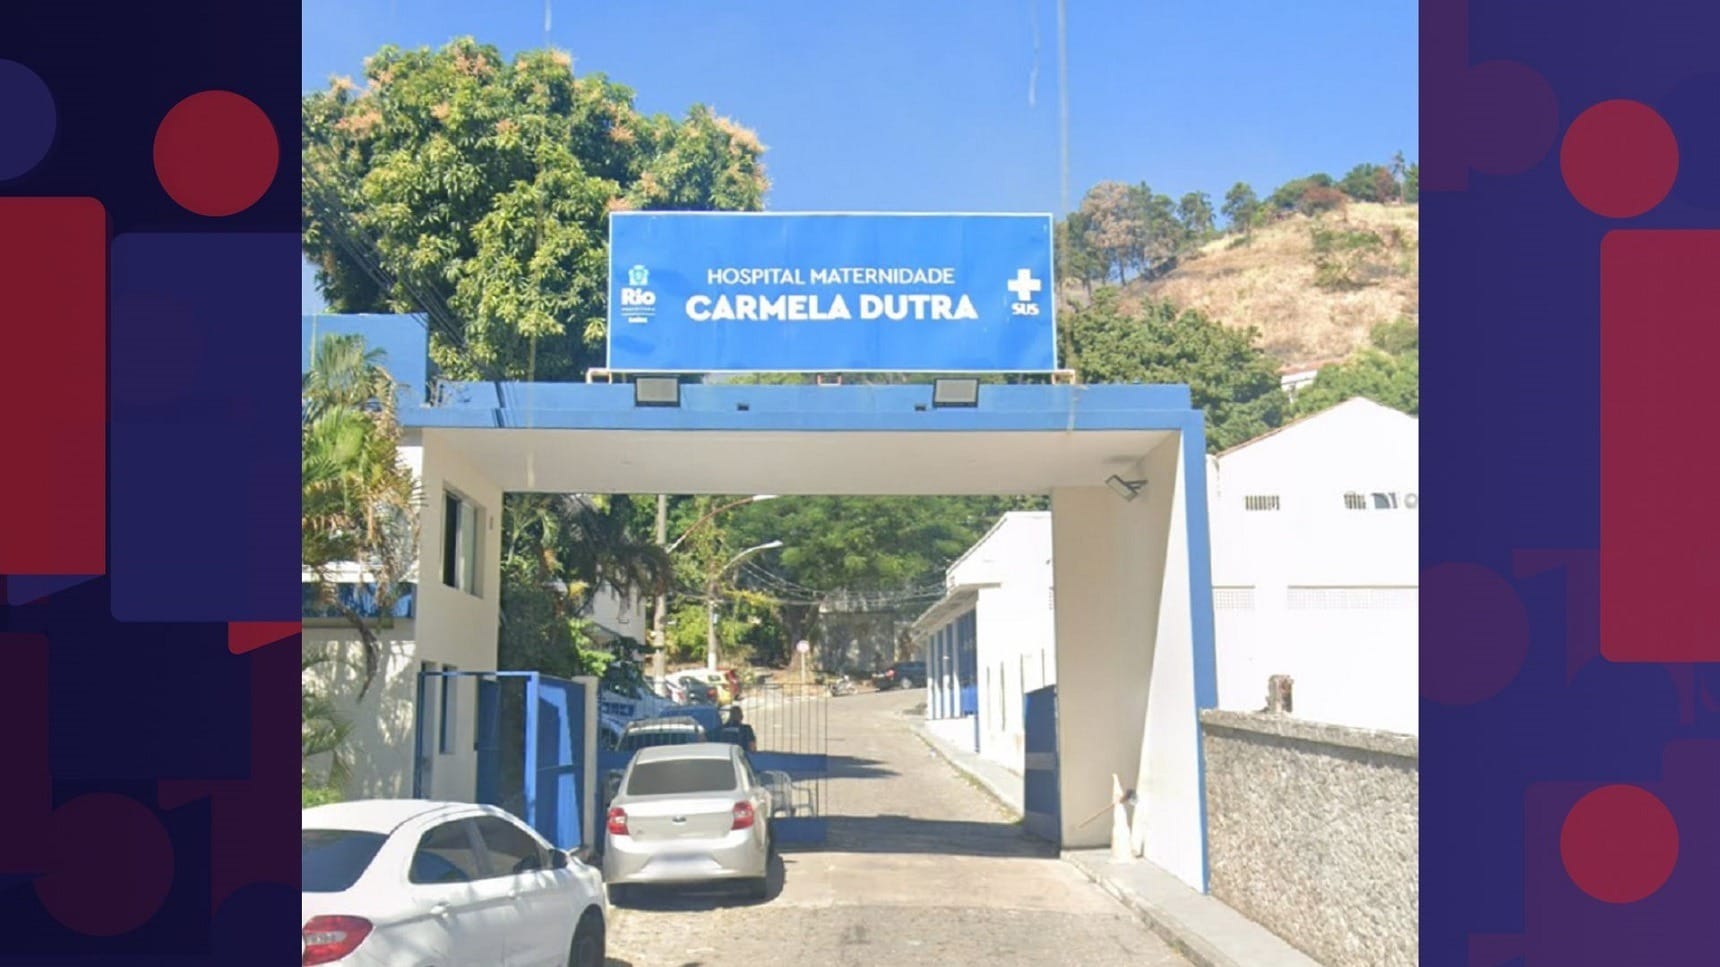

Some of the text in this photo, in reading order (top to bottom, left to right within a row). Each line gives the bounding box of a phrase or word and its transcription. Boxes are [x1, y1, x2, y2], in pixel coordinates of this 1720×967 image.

[707, 268, 955, 286] HOSPITAL MATERNIDADE
[621, 287, 656, 306] Rio
[686, 294, 978, 321] CARMELA DUTRA
[1011, 302, 1040, 316] SUS
